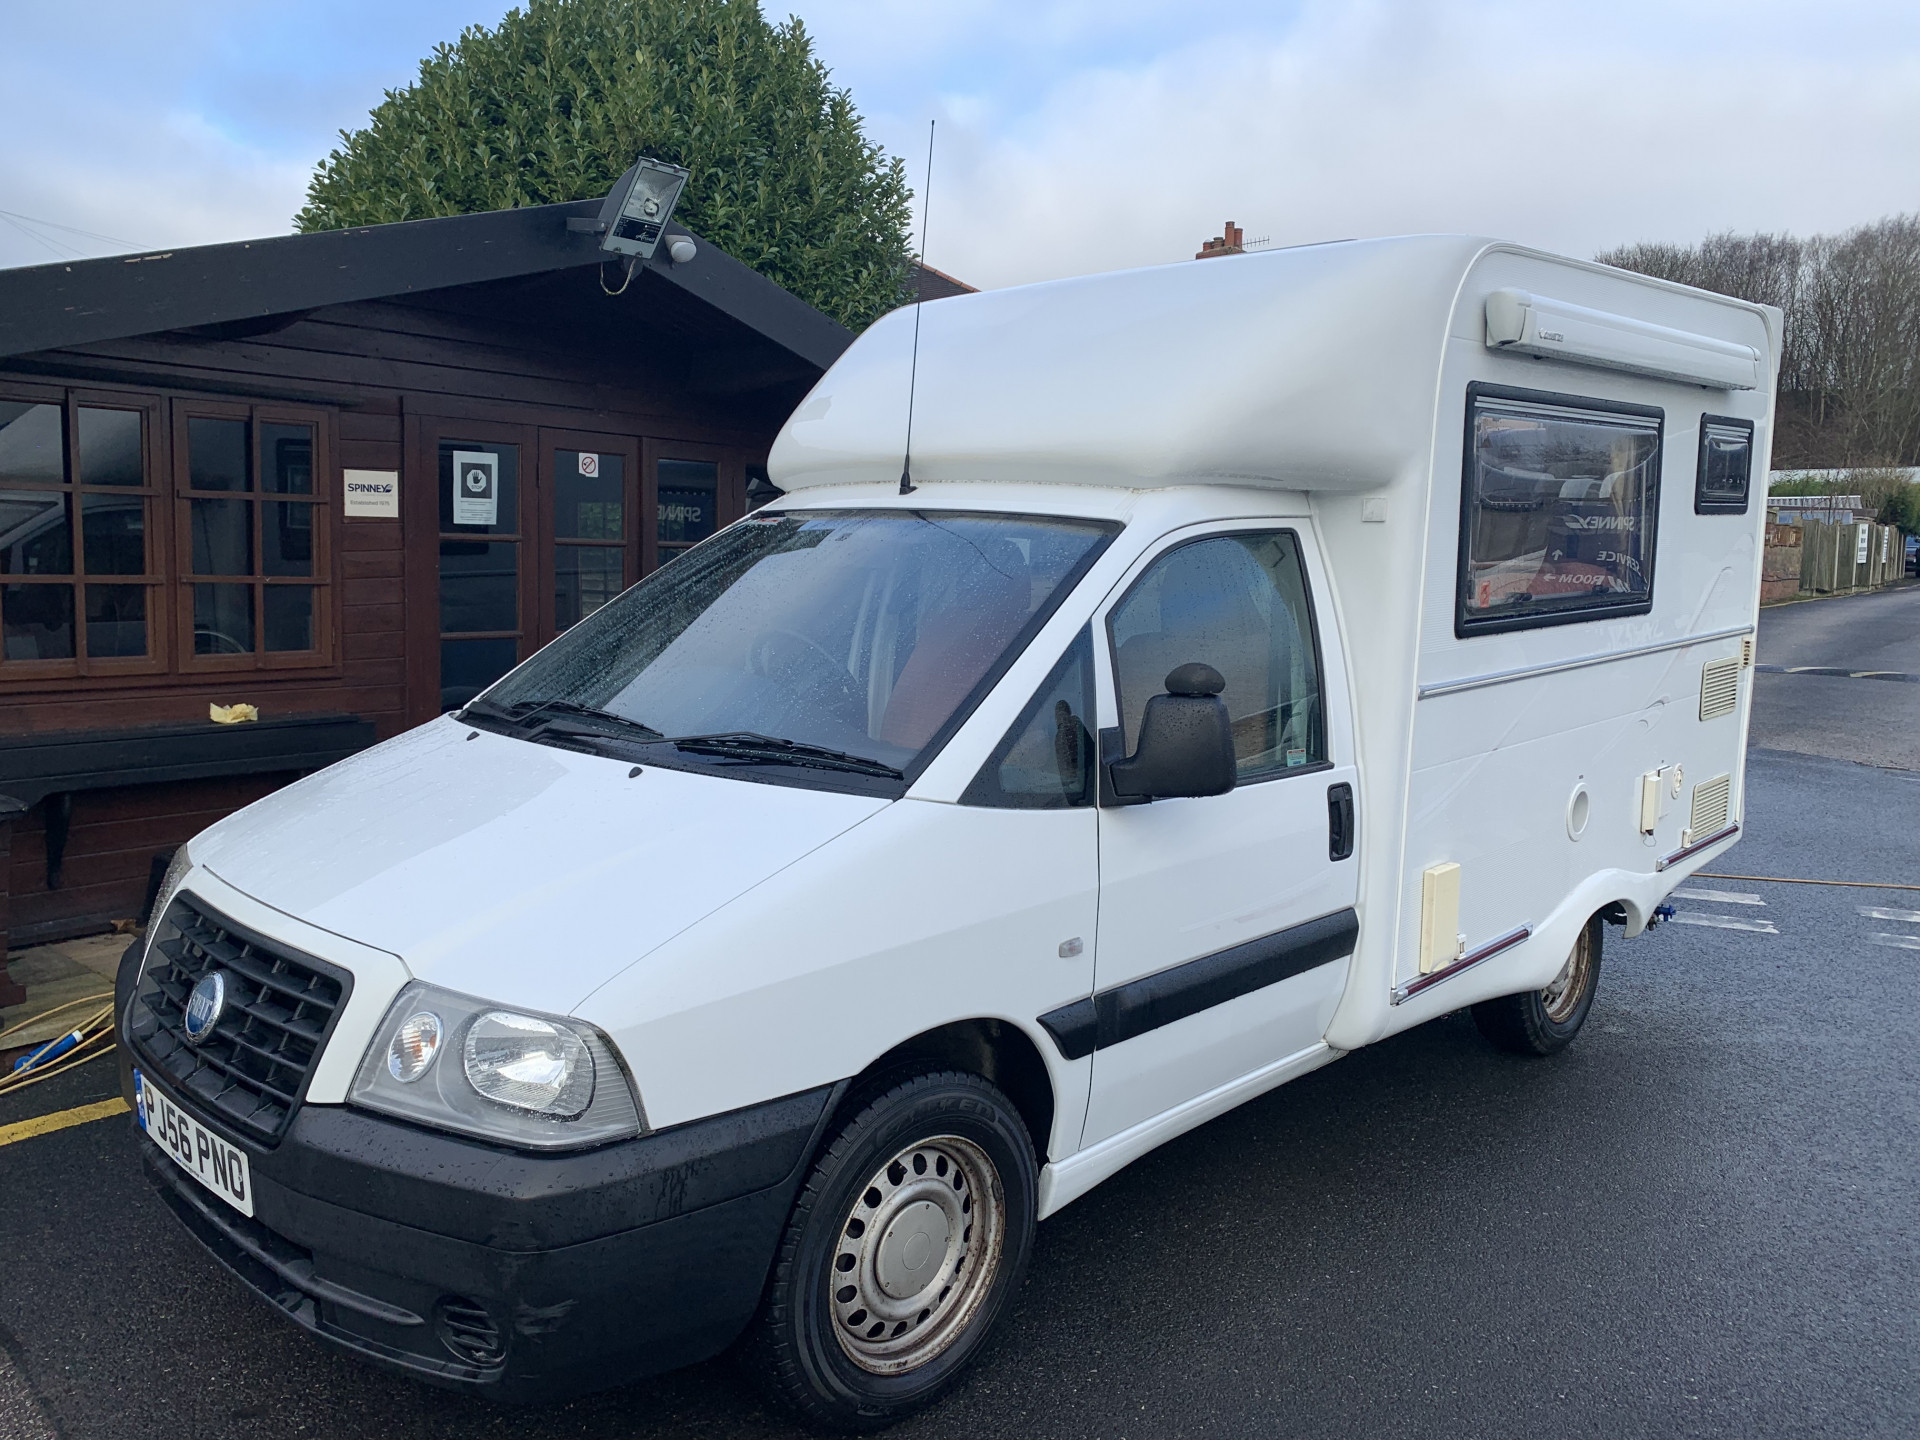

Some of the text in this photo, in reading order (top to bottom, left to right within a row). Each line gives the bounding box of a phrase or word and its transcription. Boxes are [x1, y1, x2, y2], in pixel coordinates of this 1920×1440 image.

[348, 483, 393, 493] SPINNEY
[144, 1083, 193, 1164] PJ56
[195, 1126, 245, 1202] PNO
